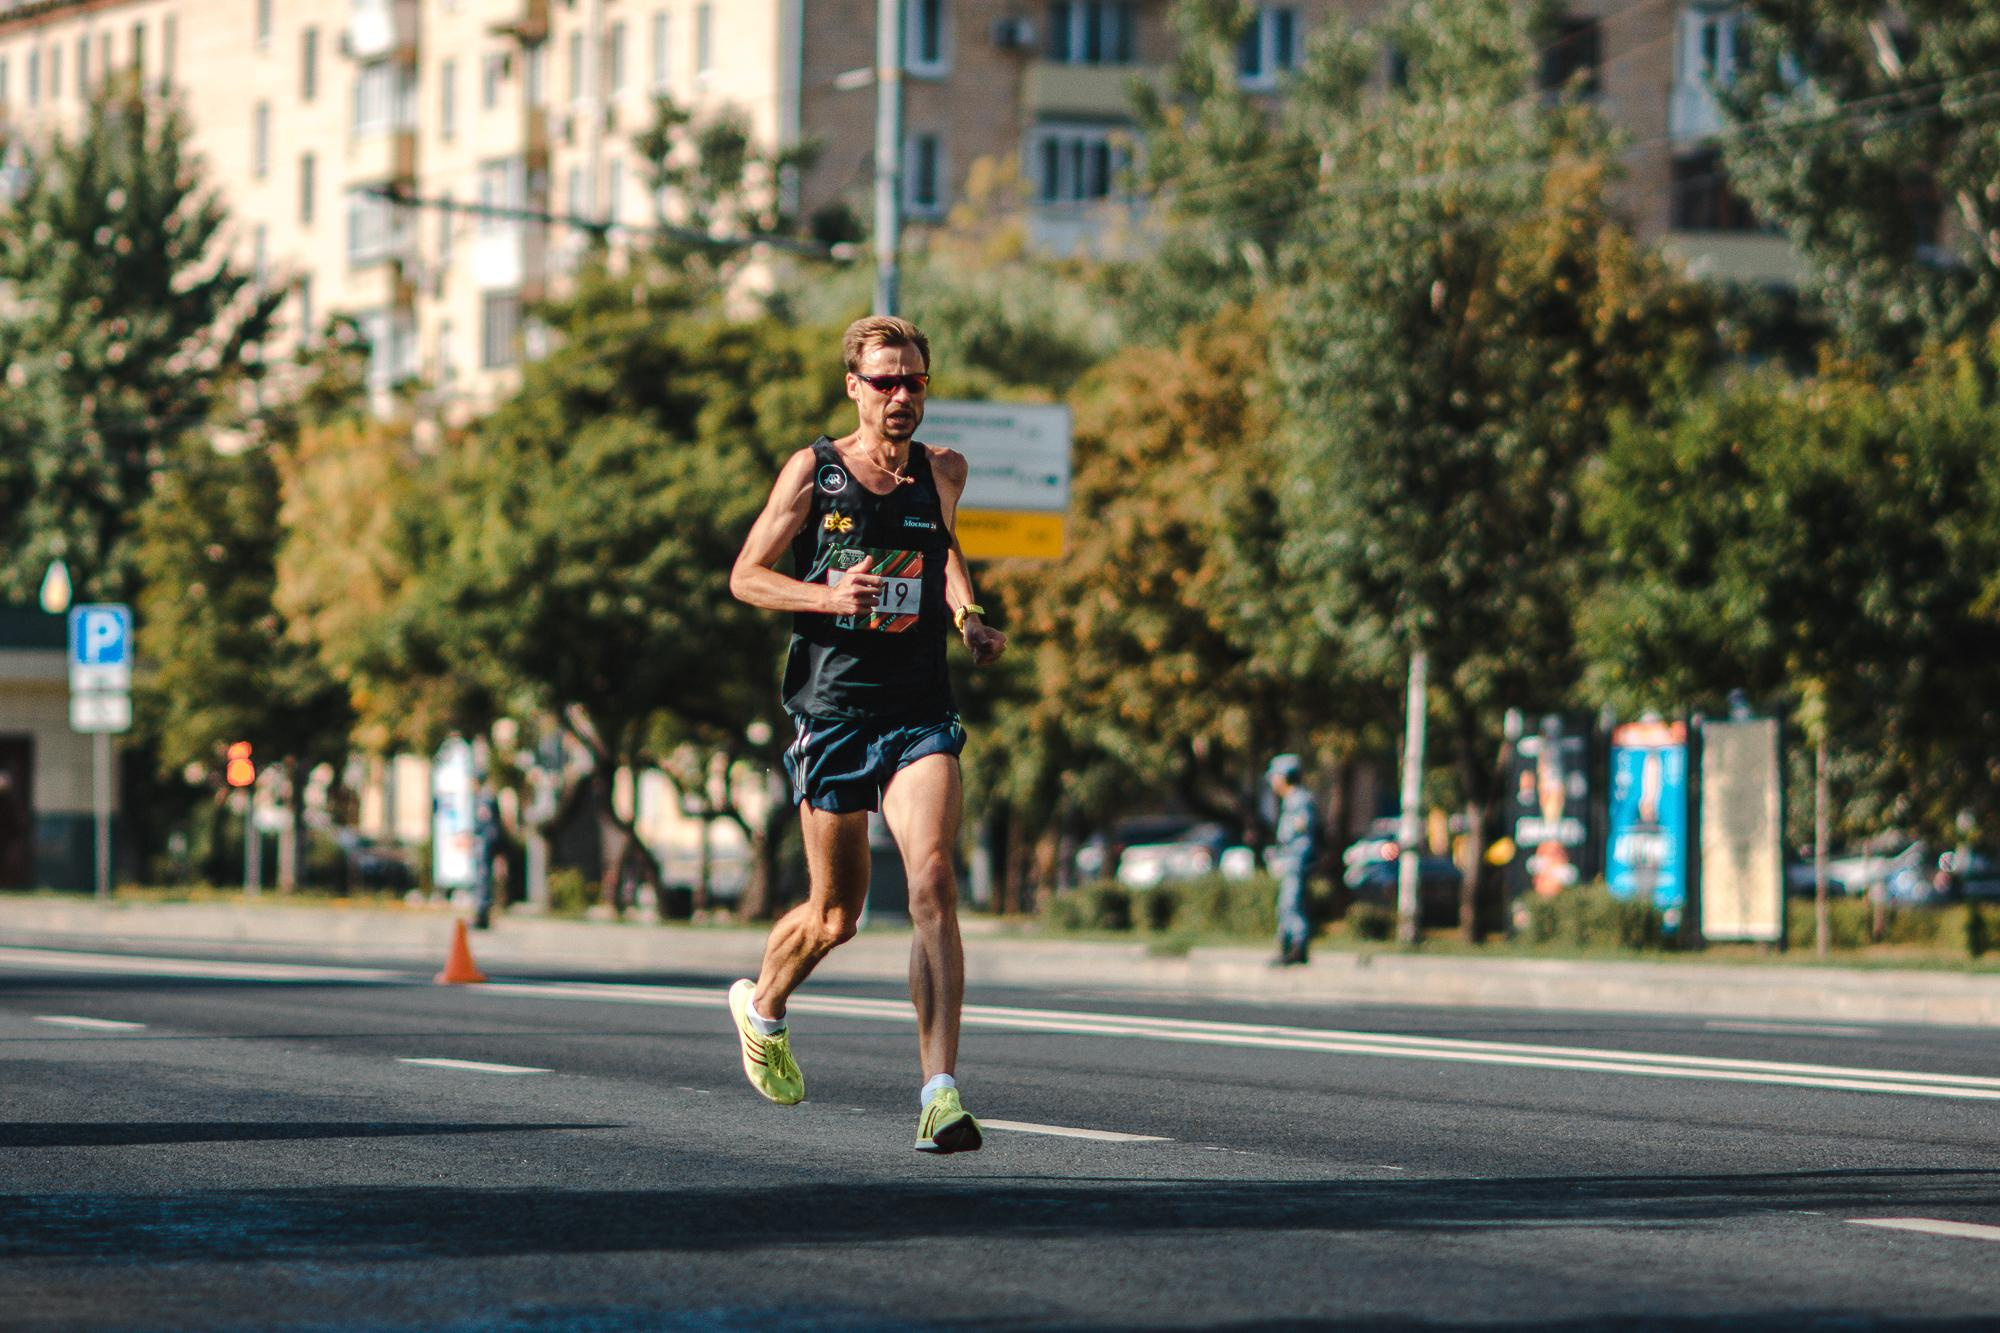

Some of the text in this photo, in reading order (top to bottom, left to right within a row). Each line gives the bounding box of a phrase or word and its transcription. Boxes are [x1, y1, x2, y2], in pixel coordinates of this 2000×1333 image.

[903, 519, 930, 529] Москва
[839, 615, 851, 628] A
[86, 611, 121, 662] P
